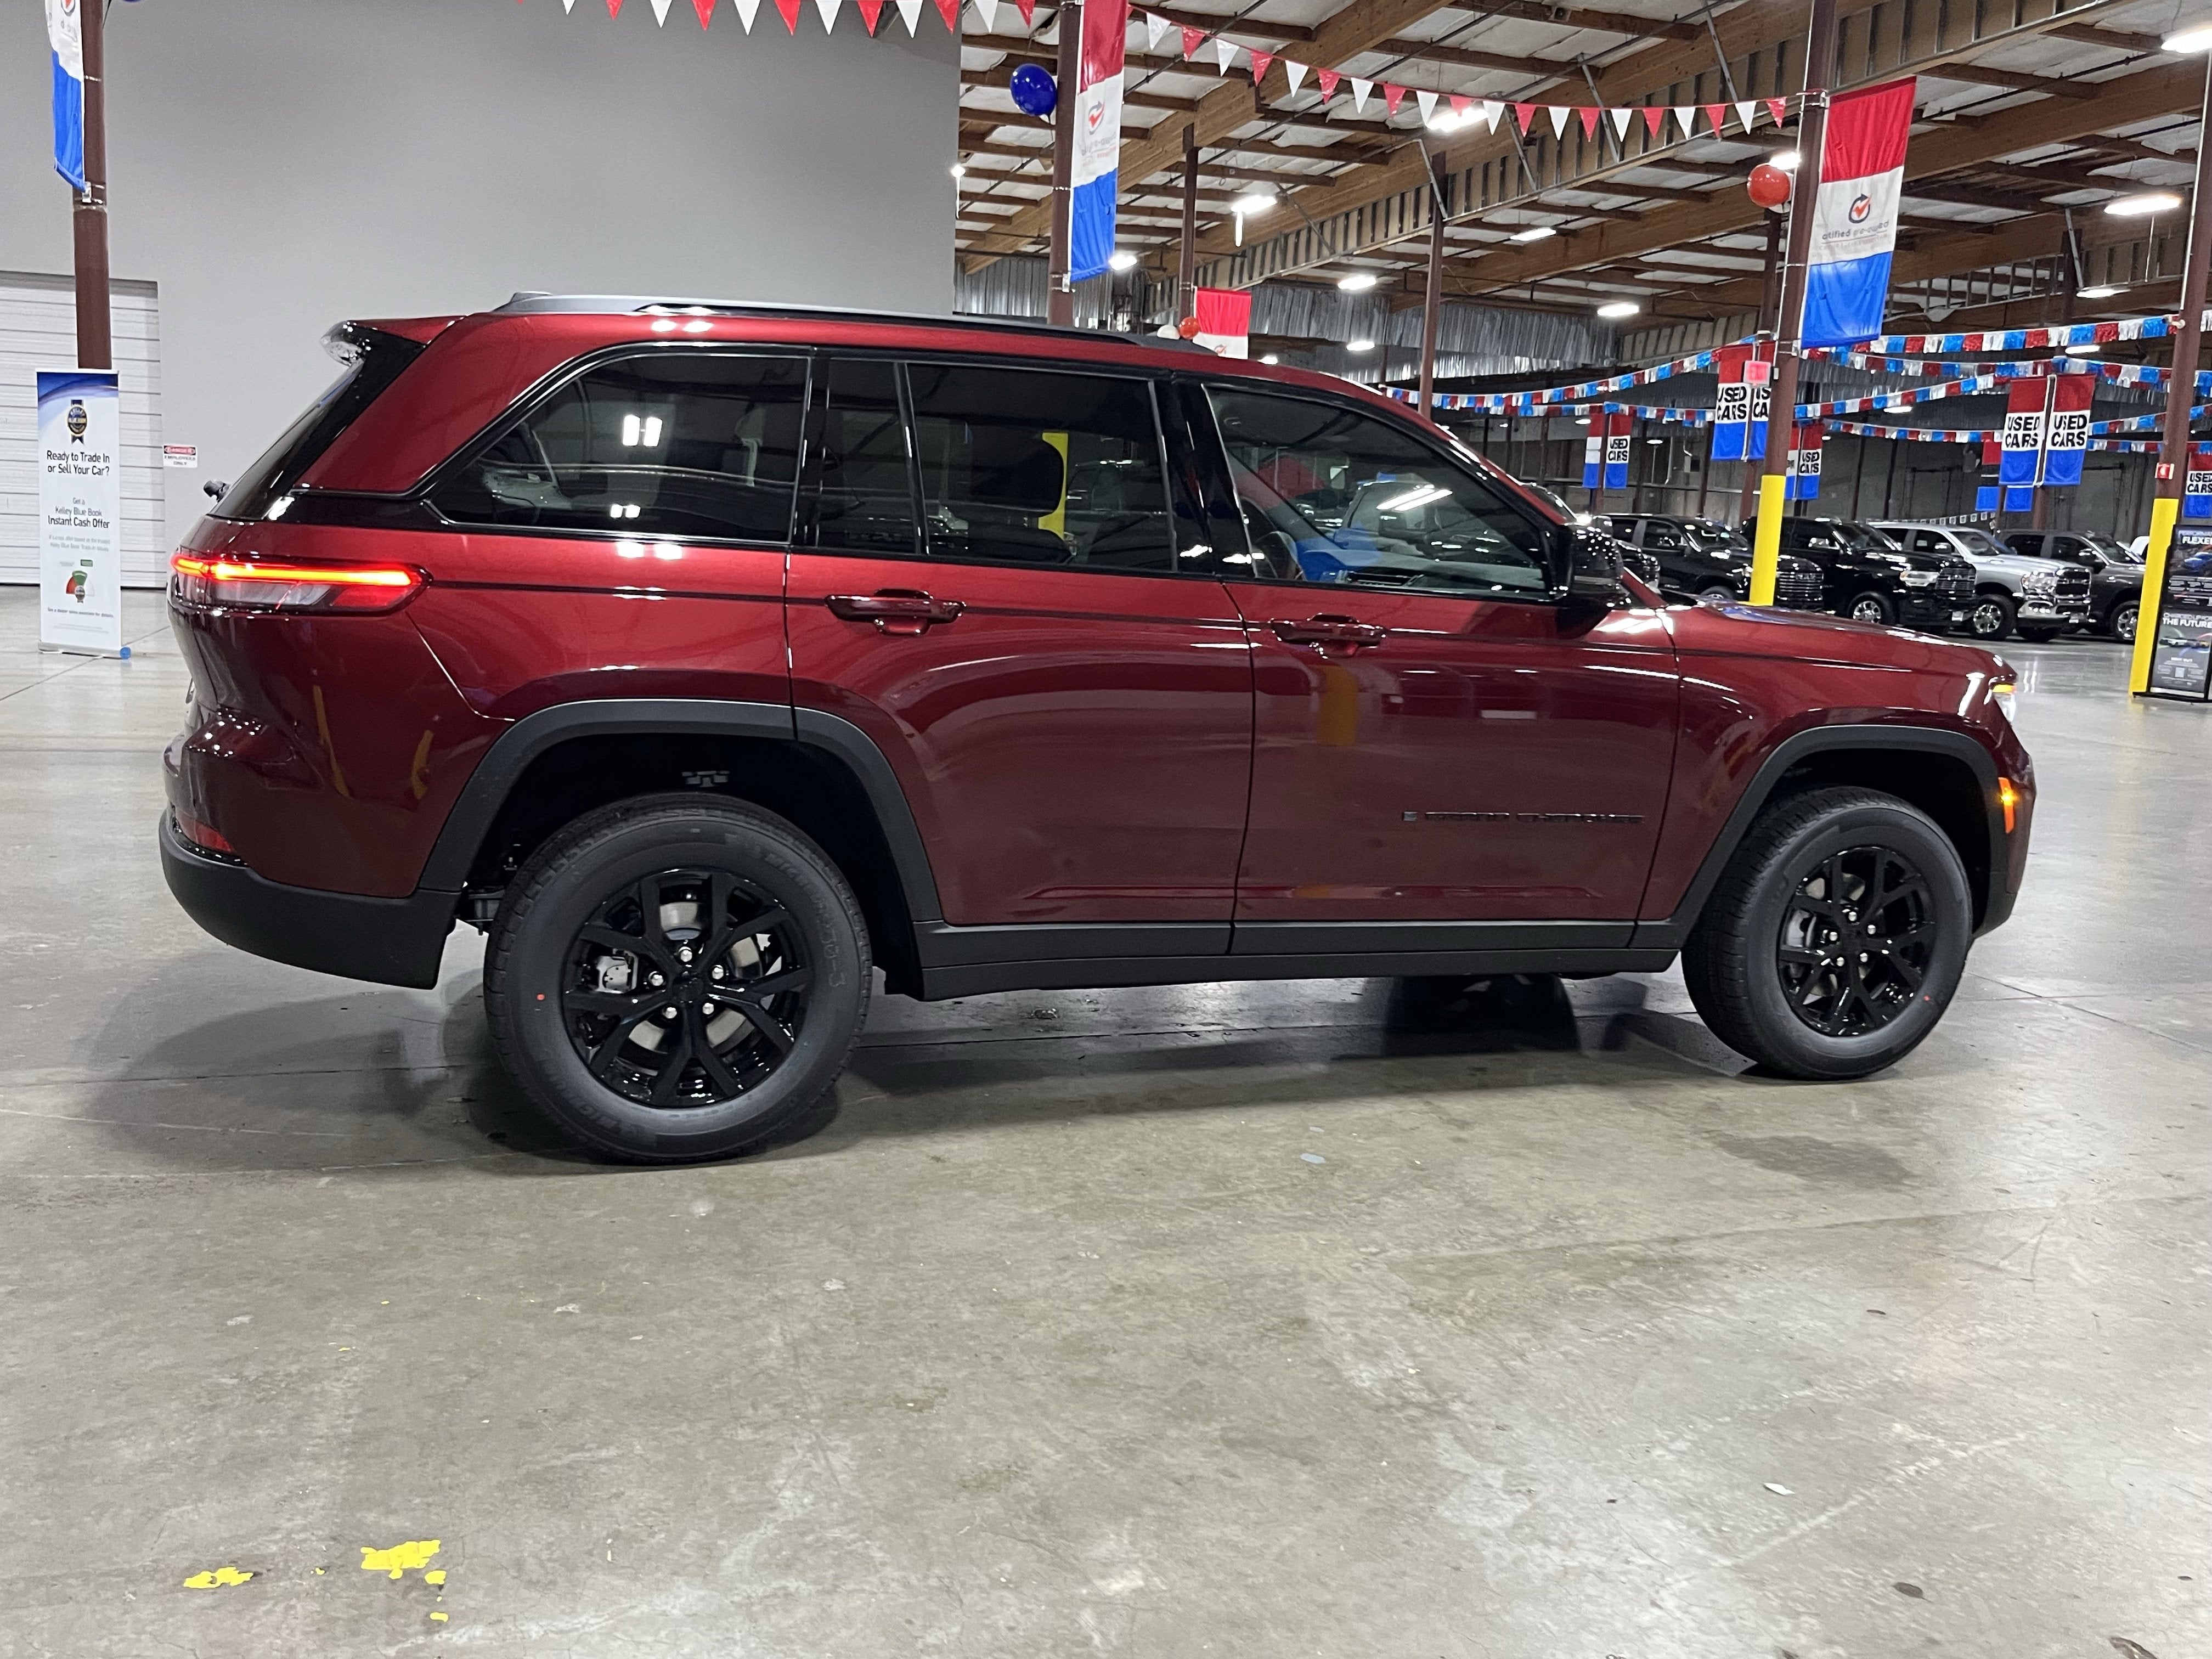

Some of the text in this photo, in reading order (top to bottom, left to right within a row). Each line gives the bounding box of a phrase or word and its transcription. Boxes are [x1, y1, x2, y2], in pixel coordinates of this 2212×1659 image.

[1717, 386, 1747, 402] USED
[1717, 403, 1747, 420] CARS
[1753, 402, 1769, 417] CA
[2007, 416, 2040, 431] USED
[2054, 414, 2087, 430] USED
[1610, 438, 1628, 449] USED
[2005, 432, 2038, 448] CARS
[2051, 431, 2086, 447] CARS
[47, 450, 110, 463] Ready to Trade In
[58, 464, 72, 474] Sell
[73, 464, 90, 475] Your
[92, 465, 110, 476] Car?
[88, 508, 102, 516] Book
[48, 515, 110, 528] Instant Cash Offer
[2180, 619, 2212, 629] FUTURE
